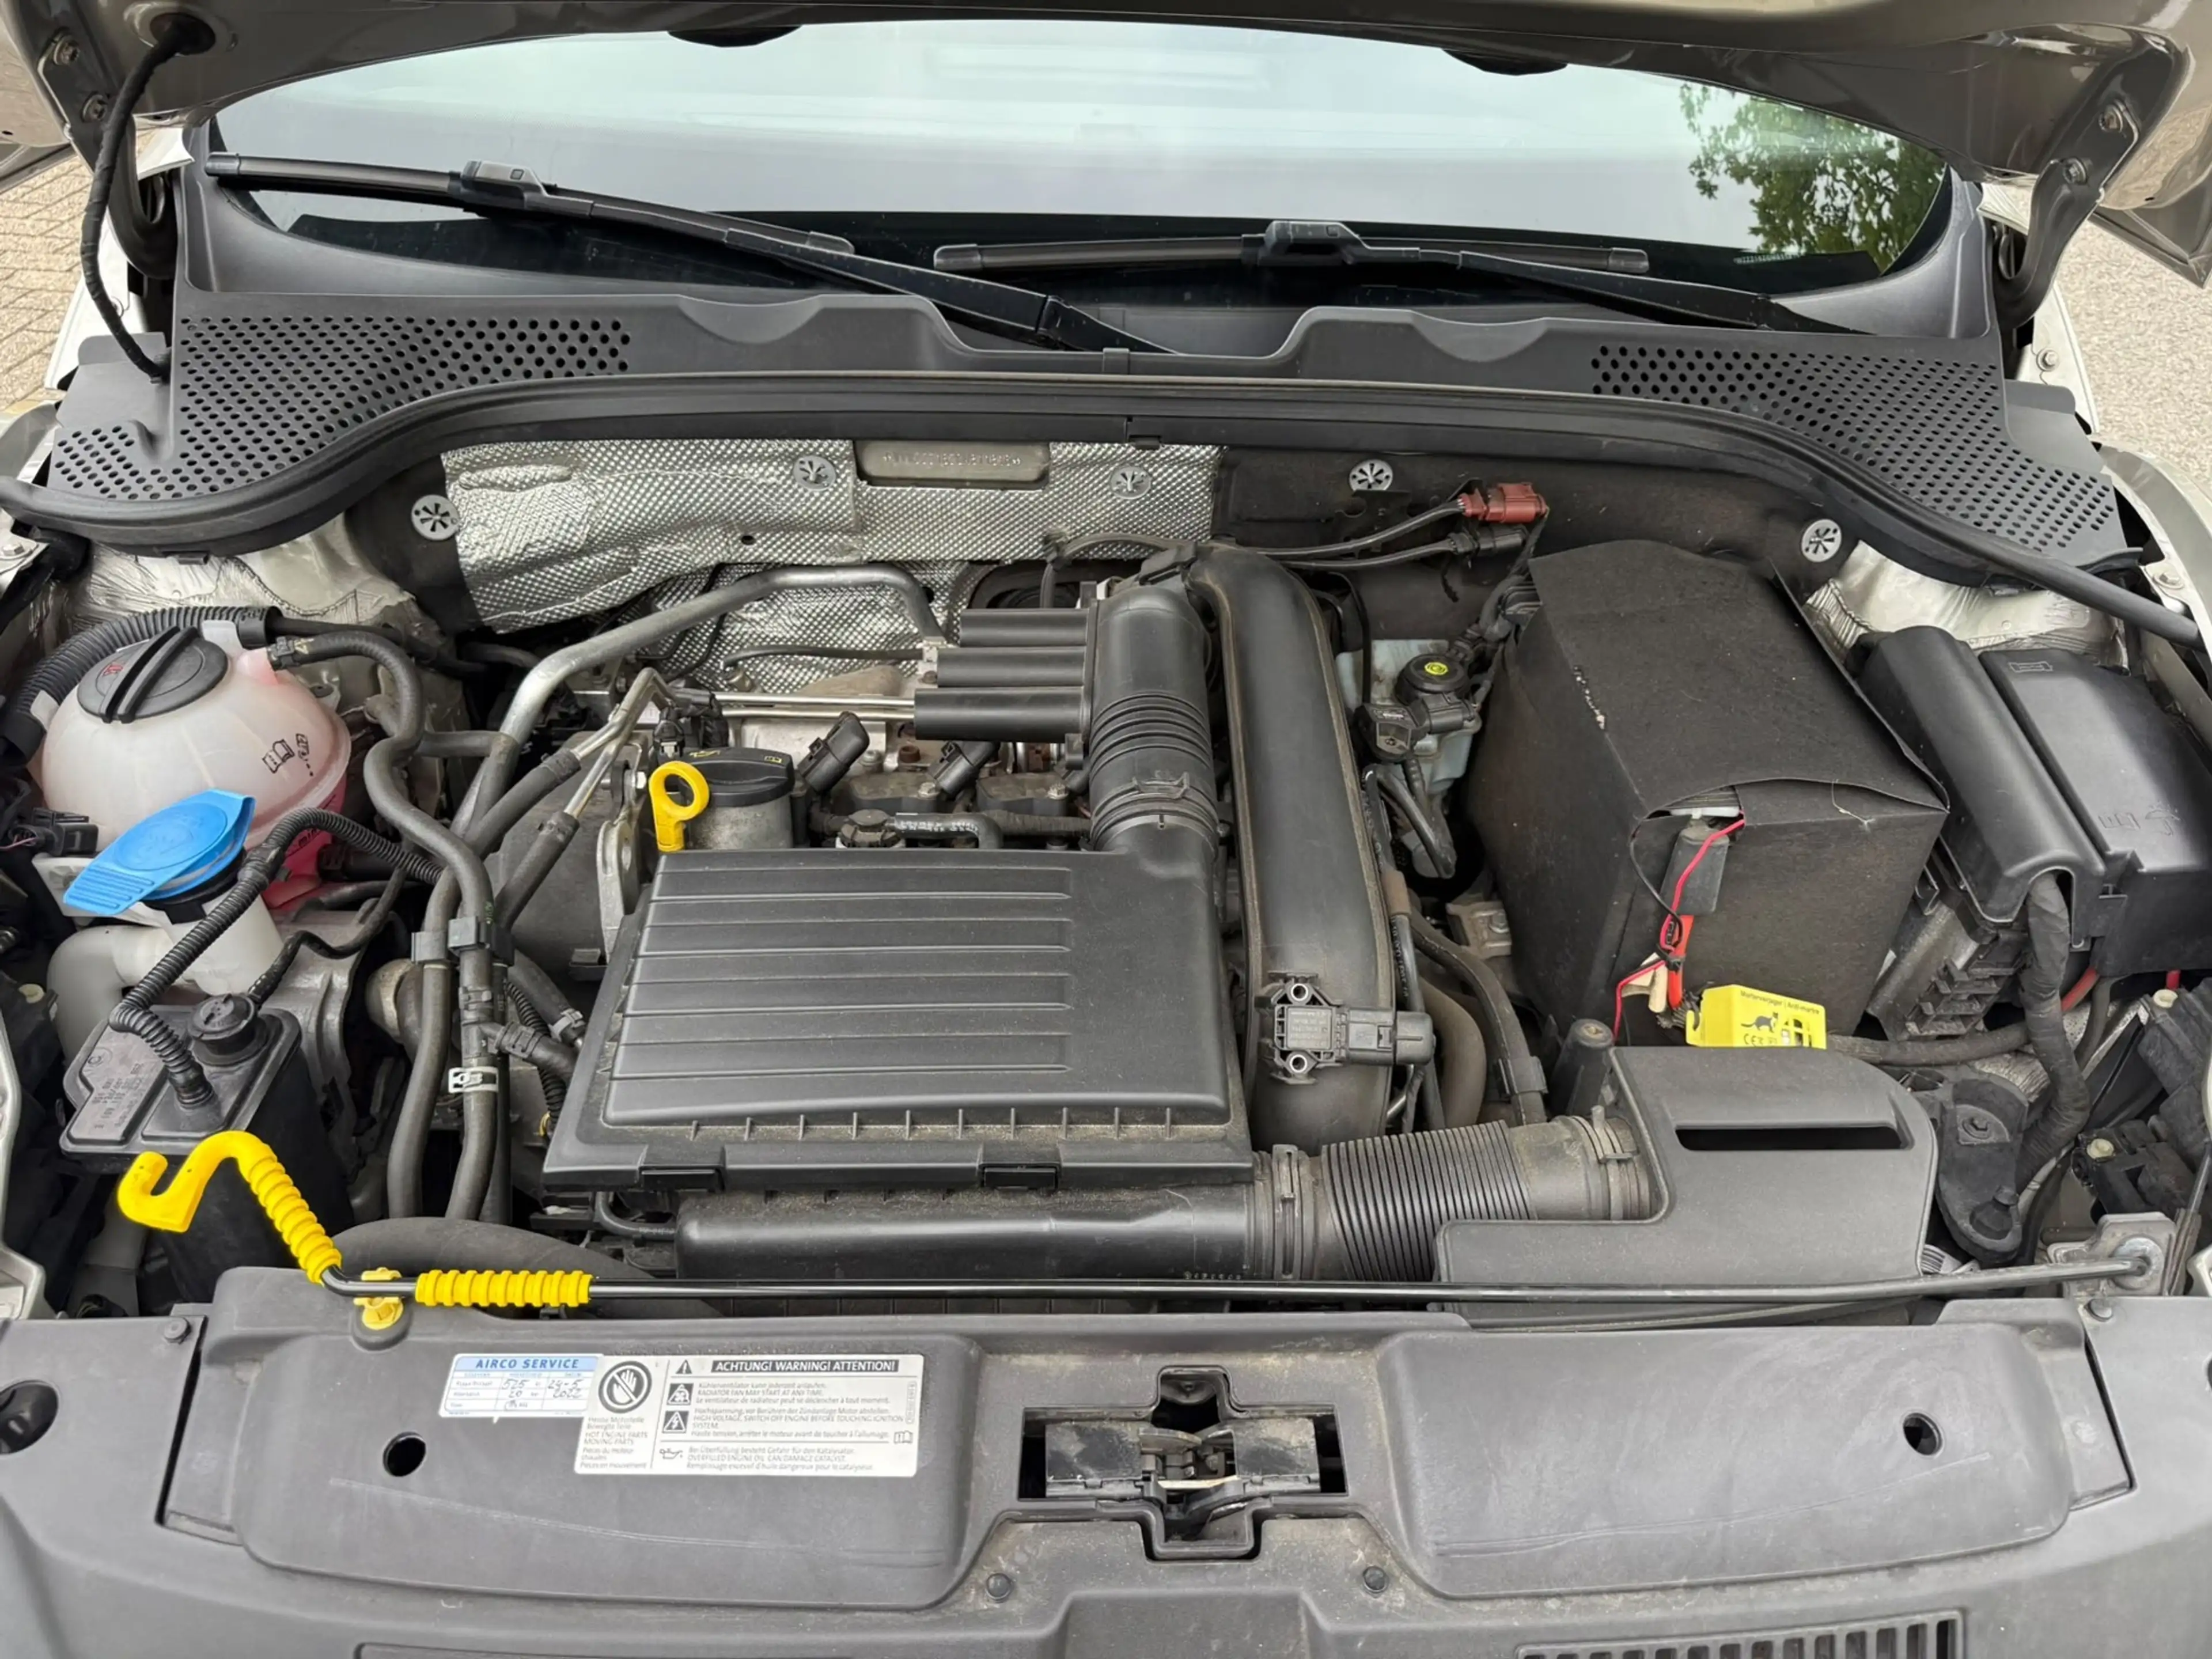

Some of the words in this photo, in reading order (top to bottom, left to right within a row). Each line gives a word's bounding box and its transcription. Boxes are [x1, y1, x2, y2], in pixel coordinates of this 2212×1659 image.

[475, 1358, 517, 1369] AIRCO
[522, 1358, 579, 1369] SERVICE
[715, 1361, 772, 1372] ACHTUNG!
[775, 1361, 831, 1372] WARNING!
[833, 1360, 895, 1372] ATTENTION!
